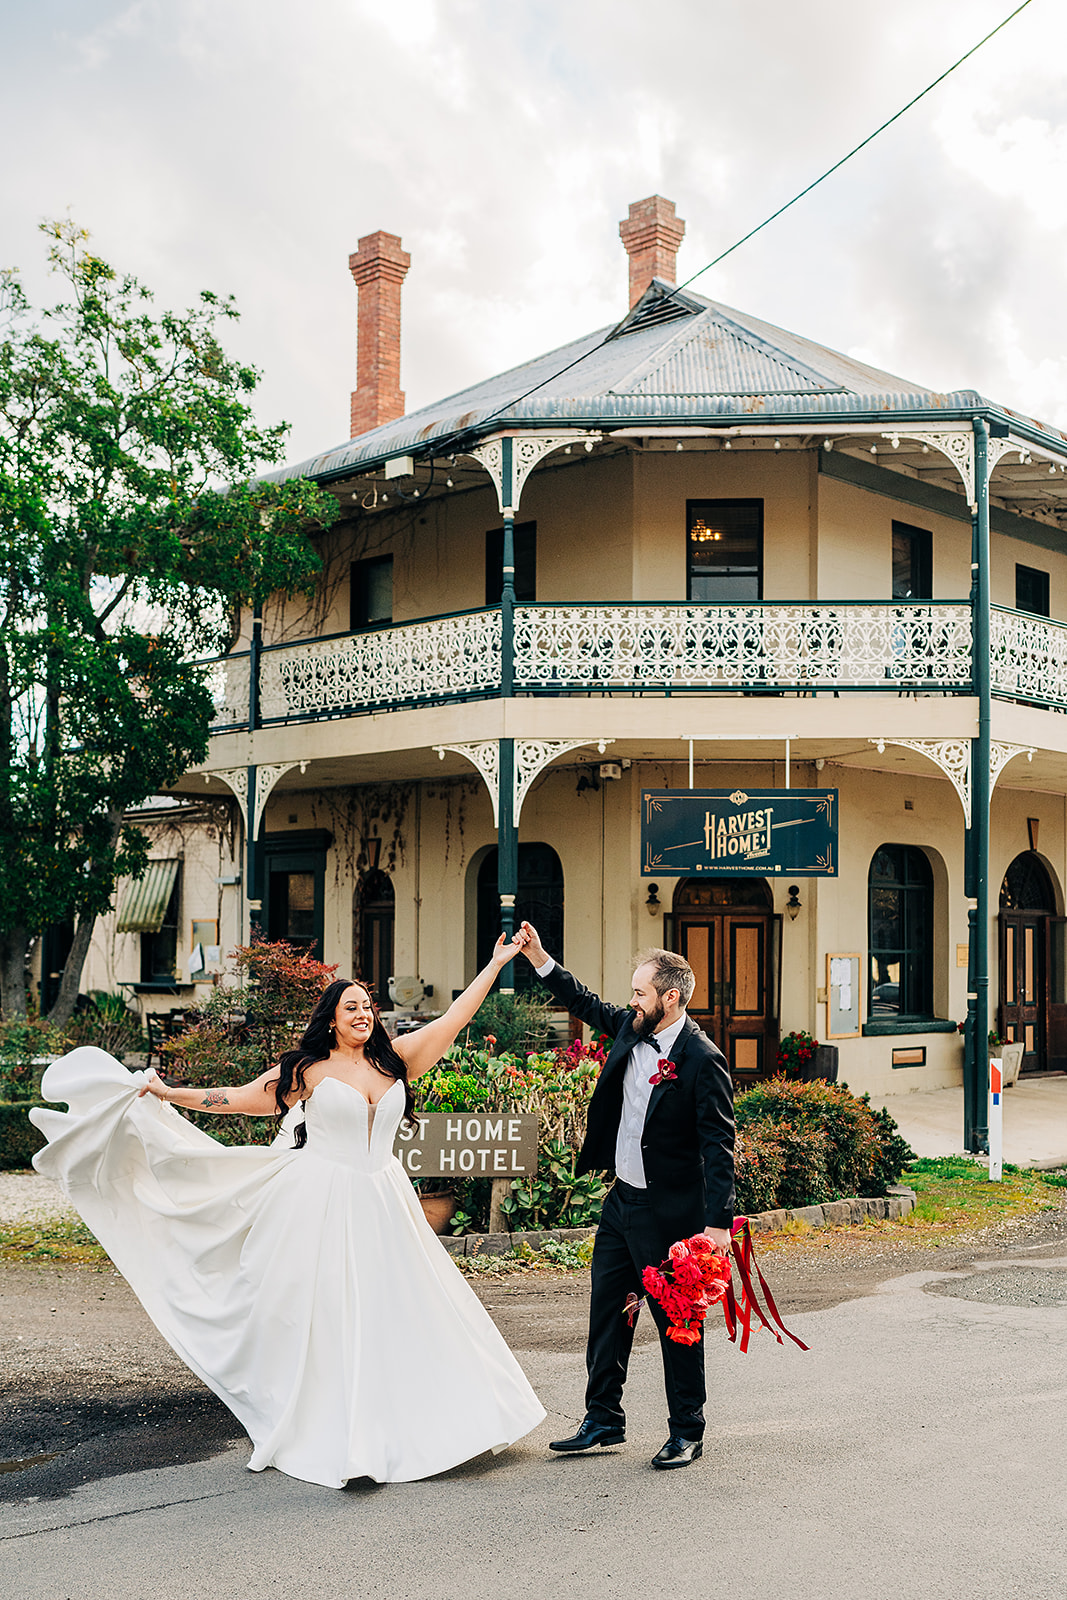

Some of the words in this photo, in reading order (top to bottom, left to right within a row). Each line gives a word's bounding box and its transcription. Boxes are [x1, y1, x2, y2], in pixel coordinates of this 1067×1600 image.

[704, 808, 774, 859] HARVEST
[717, 832, 760, 858] HOME
[446, 1119, 522, 1141] HOME
[439, 1149, 525, 1171] HOTEL
